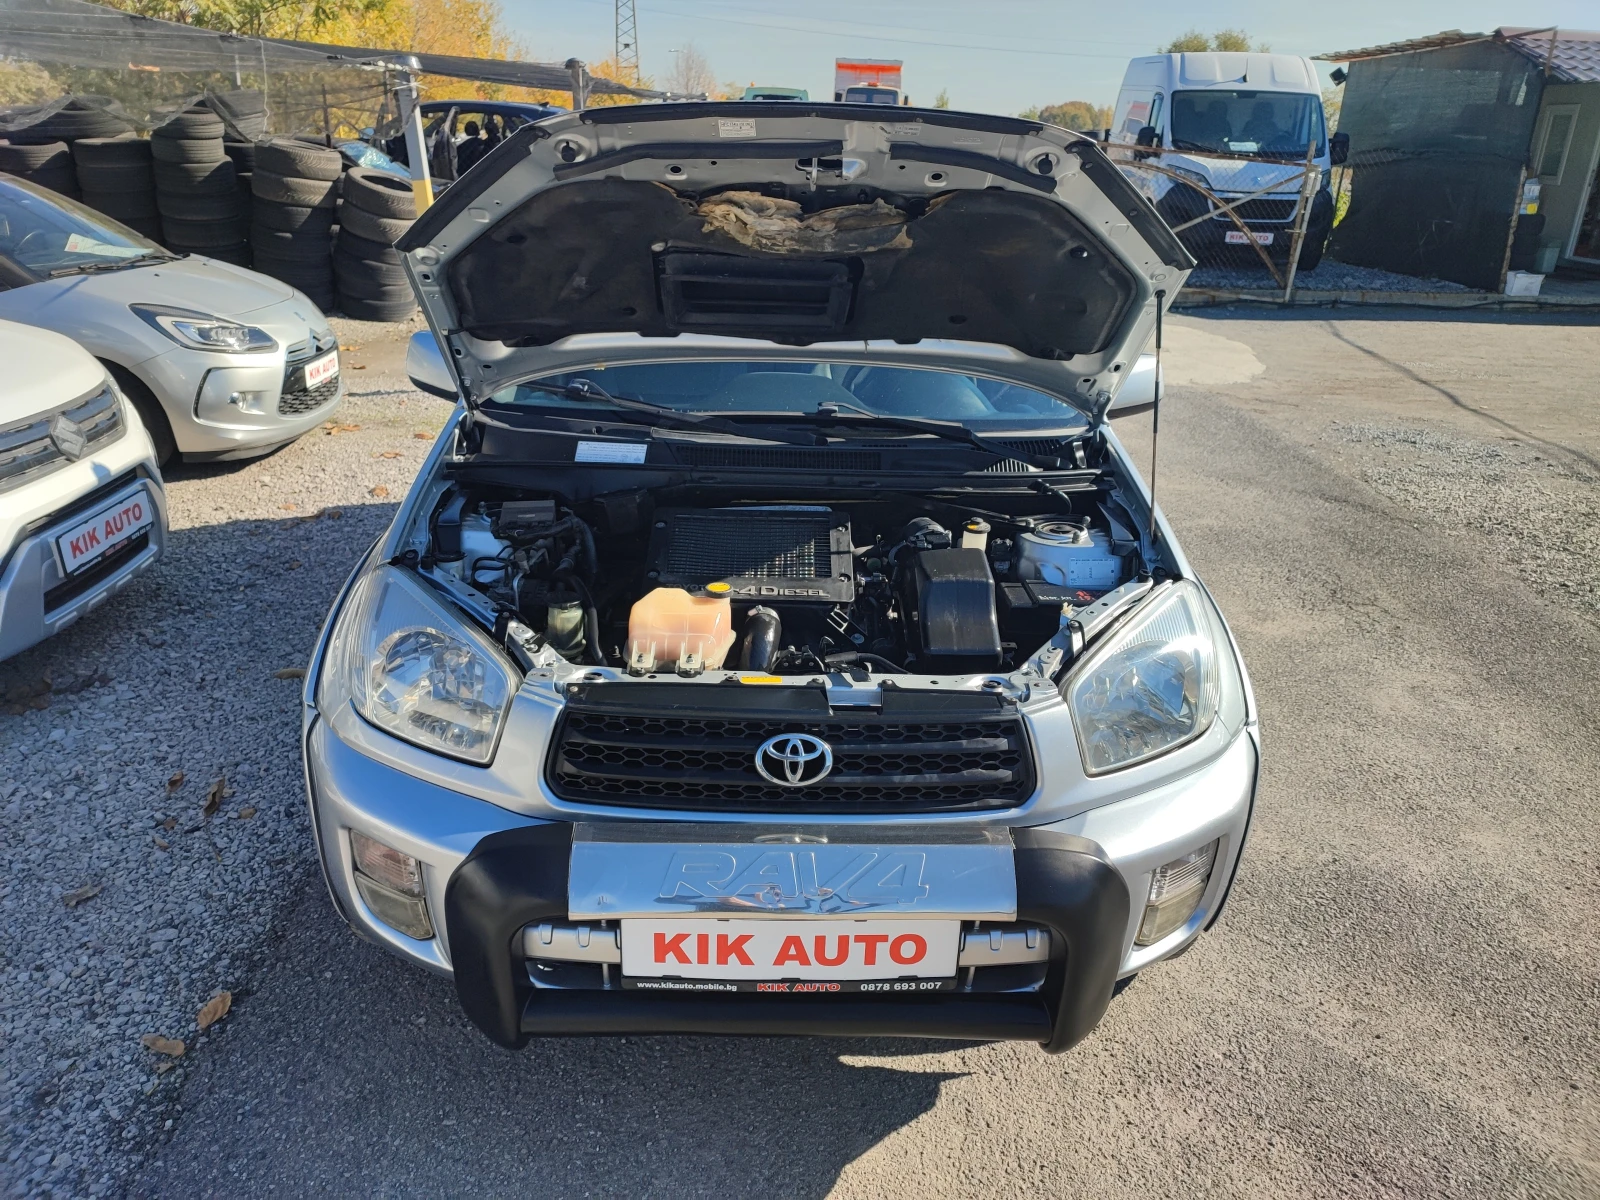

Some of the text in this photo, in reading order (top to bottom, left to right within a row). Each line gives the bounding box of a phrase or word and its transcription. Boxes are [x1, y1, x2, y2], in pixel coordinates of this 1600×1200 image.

[309, 365, 322, 380] KIK
[323, 357, 336, 374] AUTO
[69, 526, 101, 560] KIK
[105, 503, 142, 541] AUTO
[760, 585, 830, 598] DIESEL
[659, 851, 929, 905] RAV4
[653, 932, 928, 967] KIK AUTO
[637, 981, 942, 992] www.kikauto.mobile.bg KIK AUTO 0878 693 007
